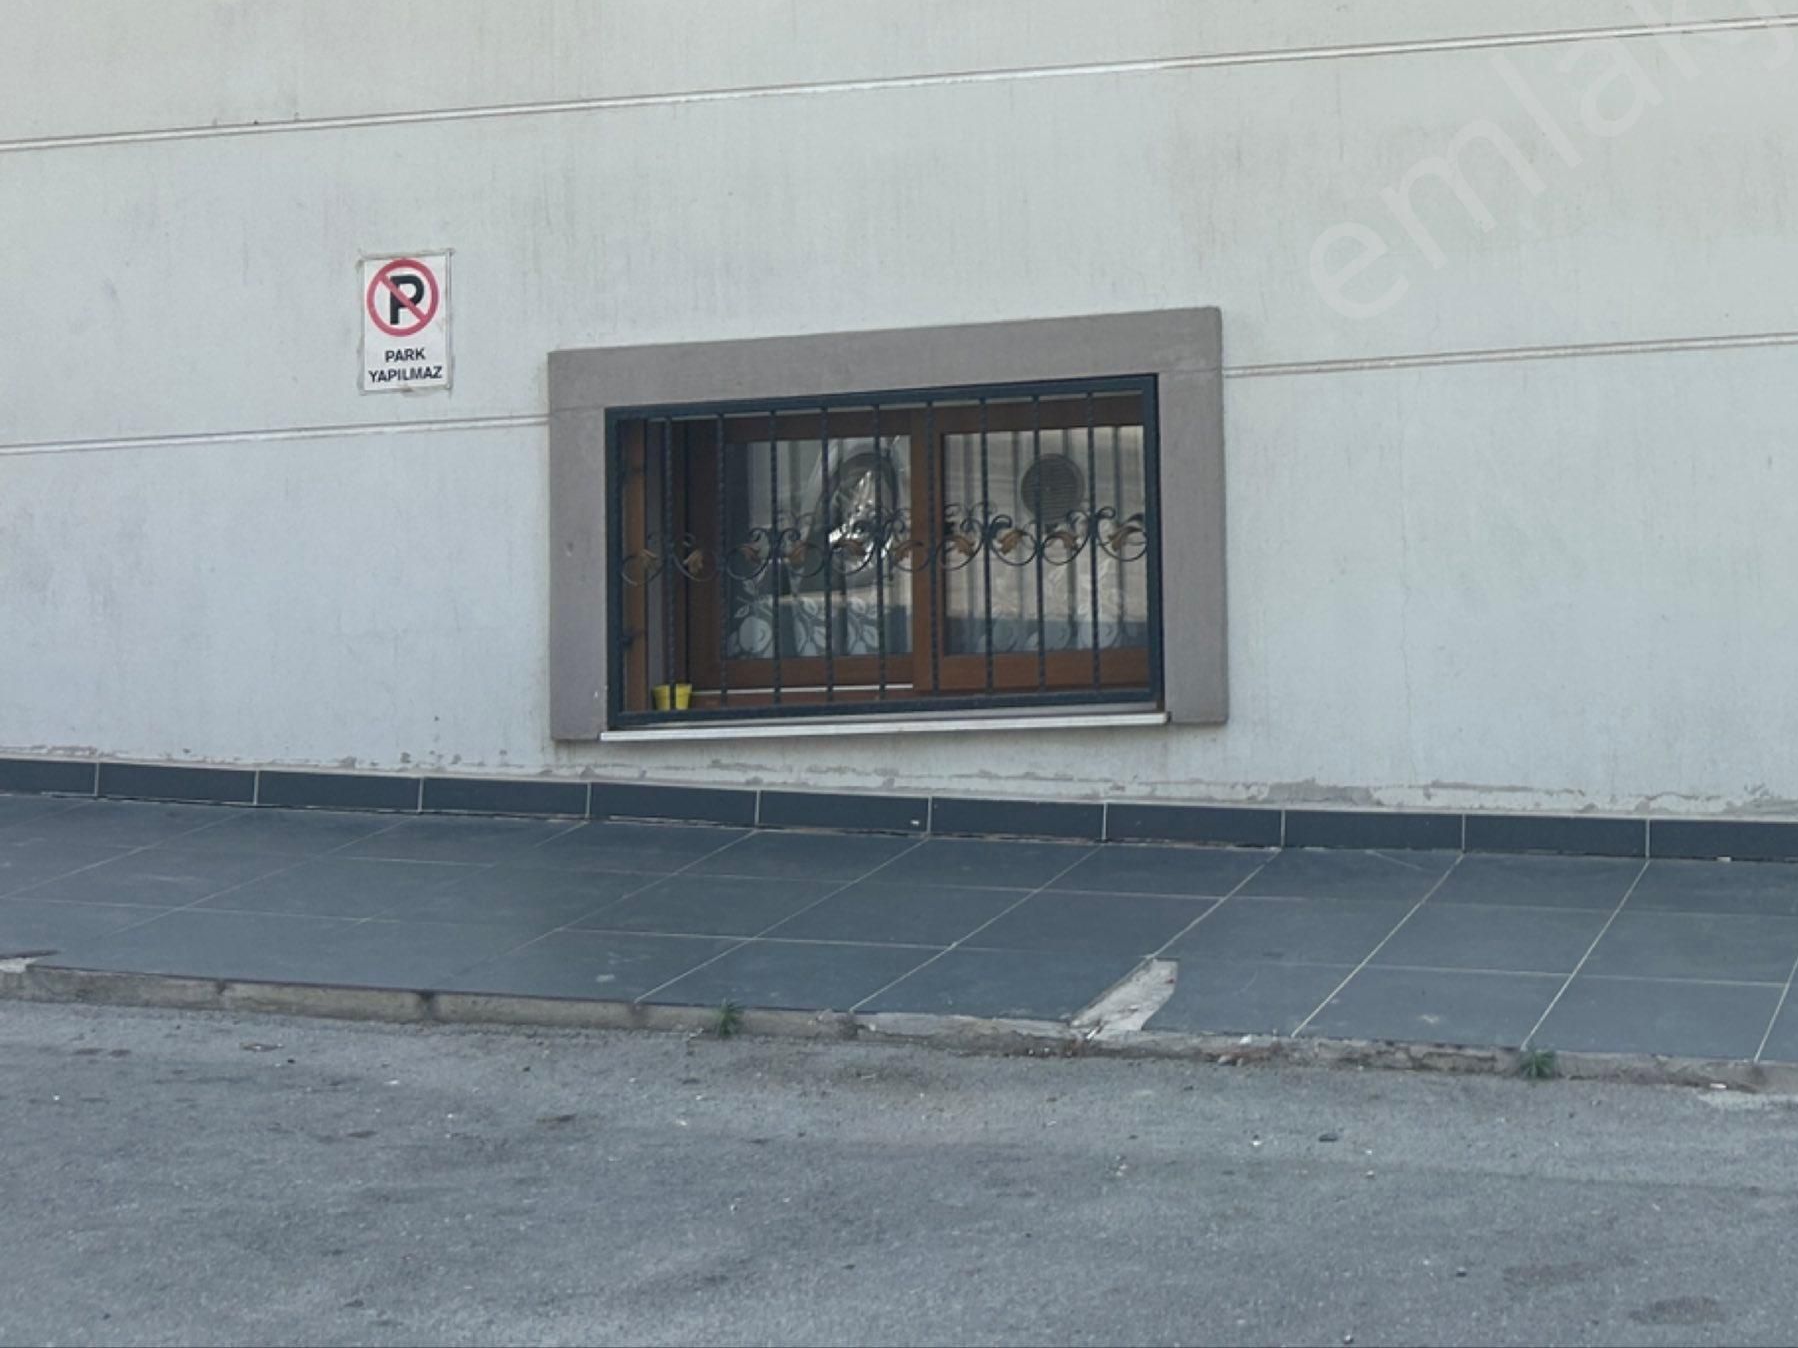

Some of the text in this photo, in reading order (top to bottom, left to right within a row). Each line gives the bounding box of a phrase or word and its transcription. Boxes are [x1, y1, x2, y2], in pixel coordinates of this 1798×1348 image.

[390, 274, 424, 325] P
[385, 348, 426, 363] PARK
[368, 366, 443, 383] YAPILMAZ
